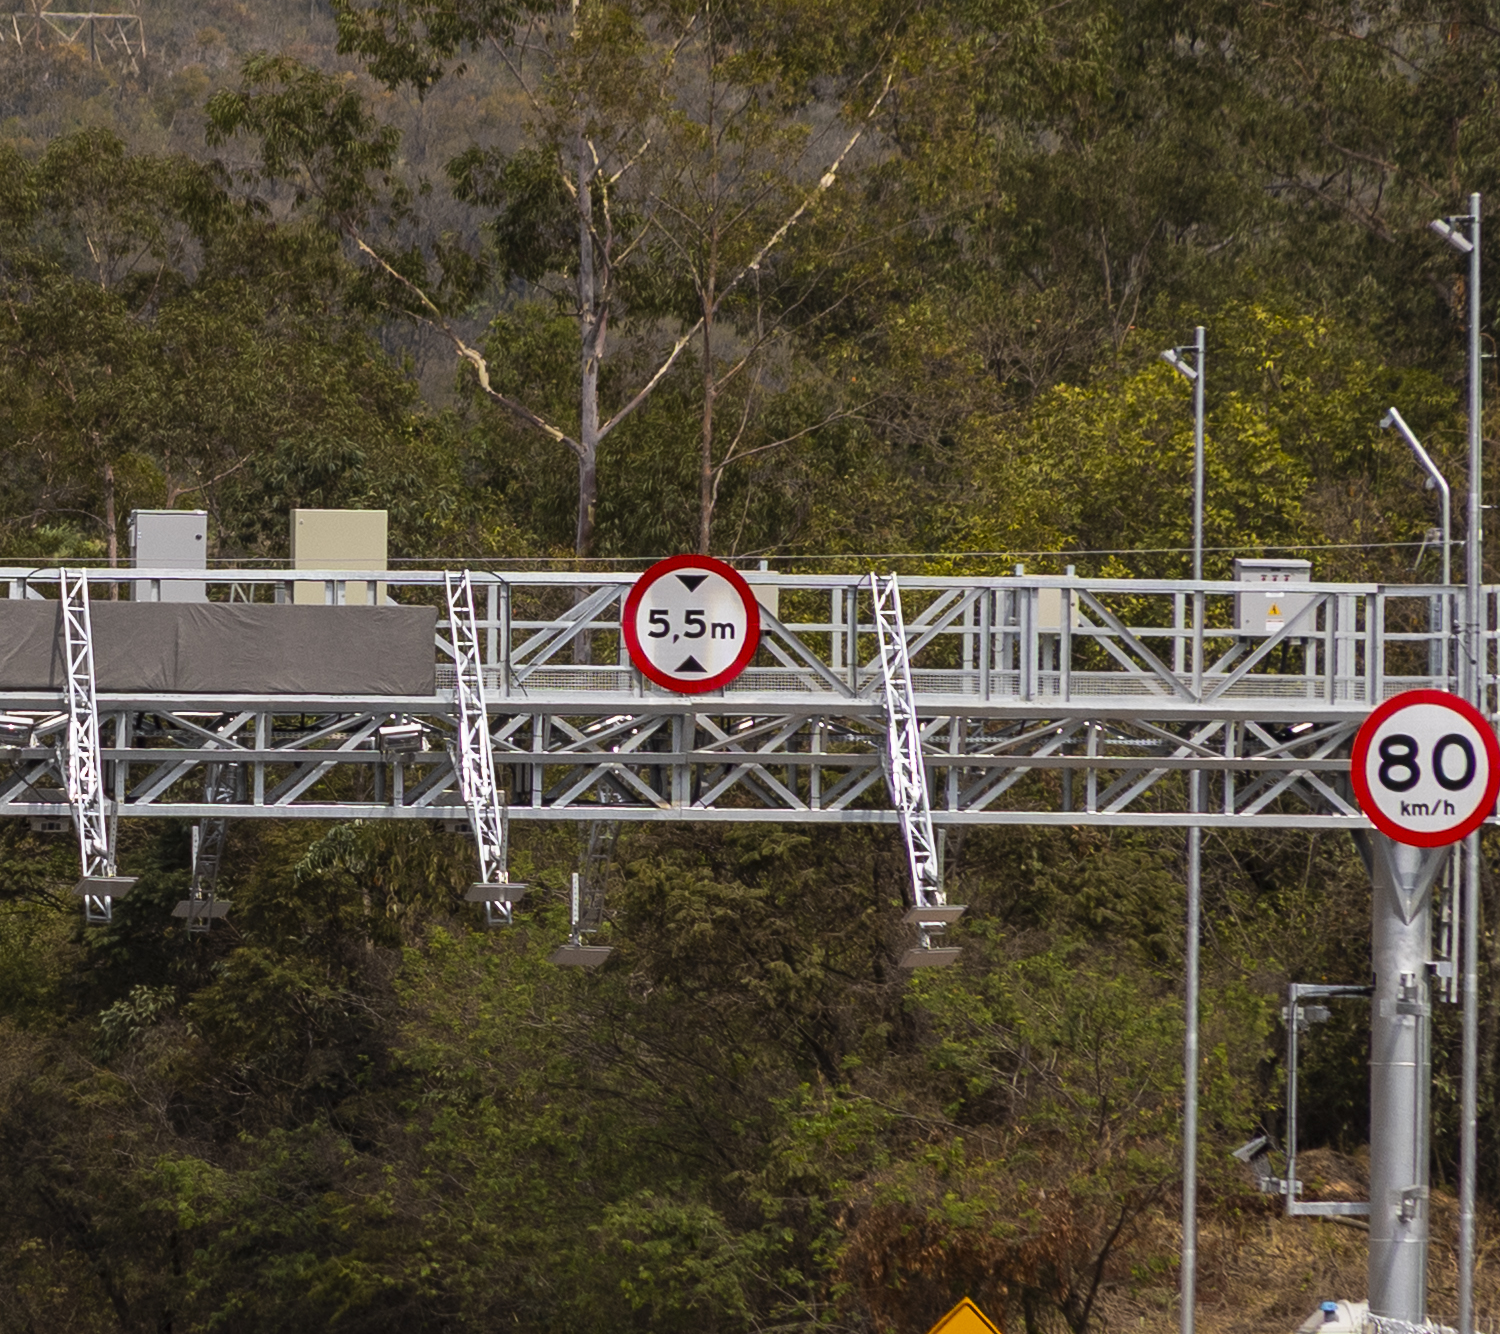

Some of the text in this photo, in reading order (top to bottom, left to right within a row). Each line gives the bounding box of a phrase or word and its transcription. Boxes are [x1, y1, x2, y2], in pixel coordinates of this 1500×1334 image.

[648, 609, 735, 644] 5,5m
[1378, 733, 1477, 792] 80
[1400, 799, 1455, 816] km/h
